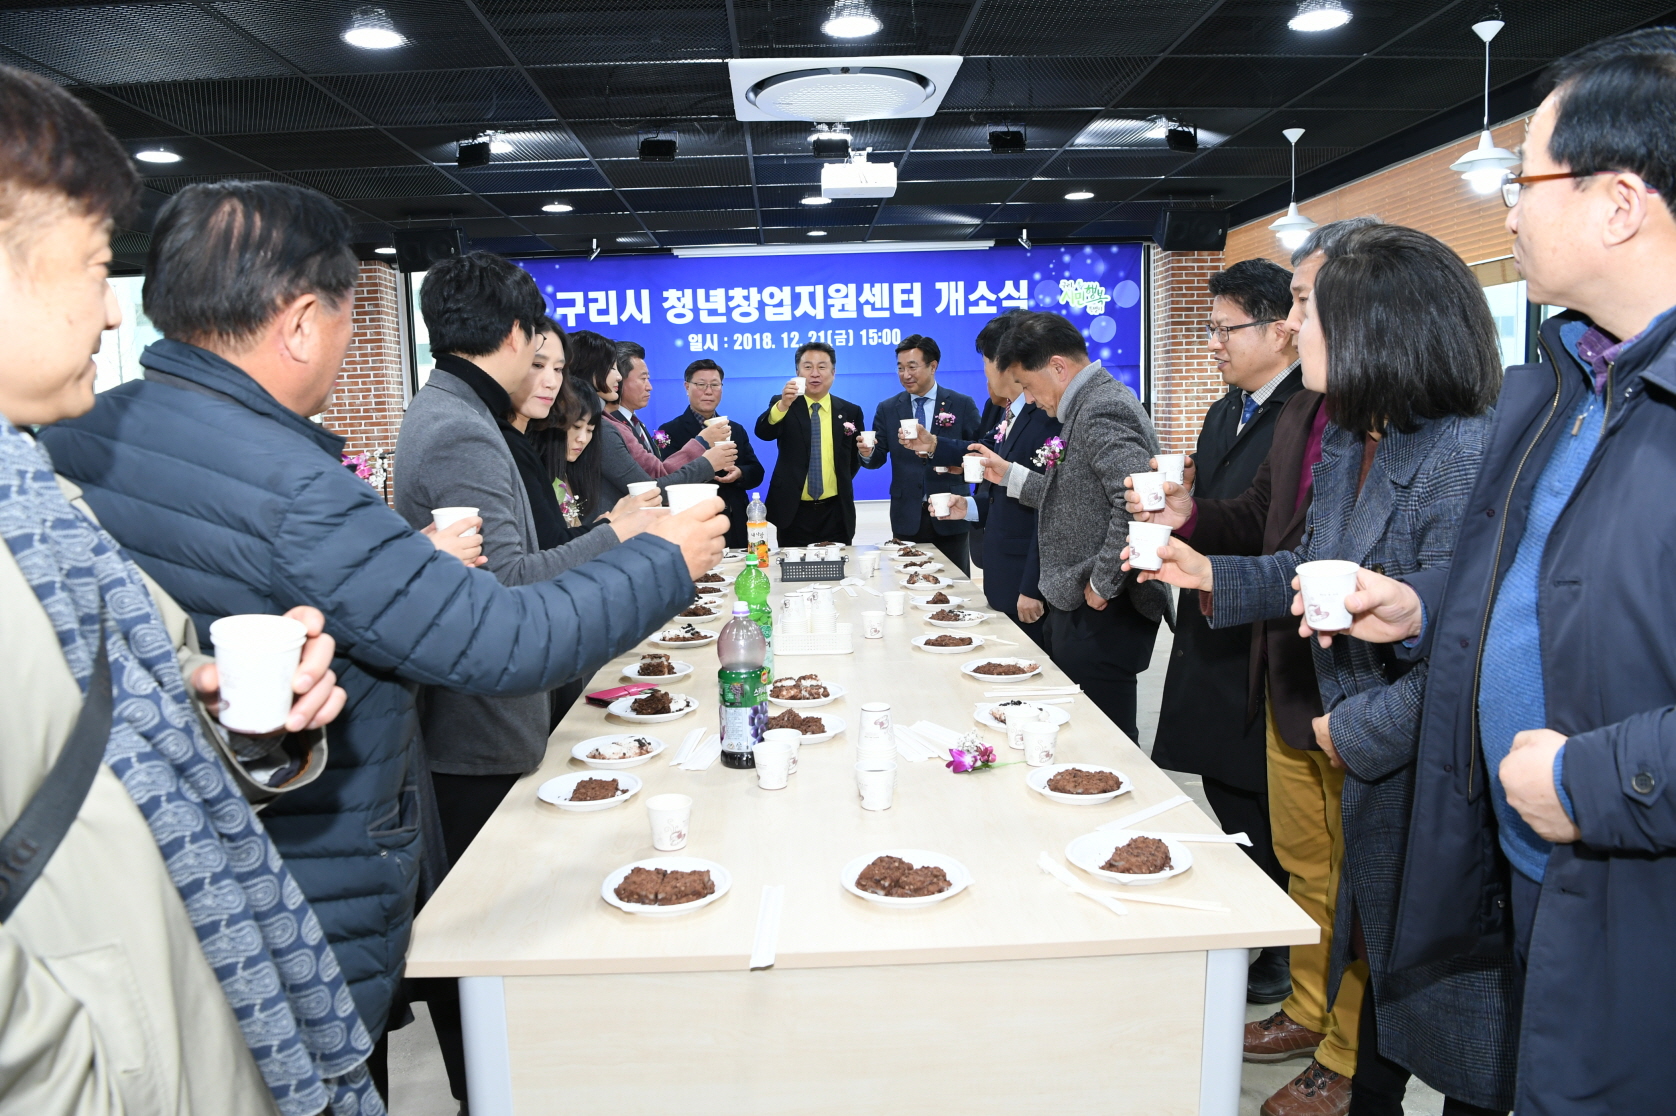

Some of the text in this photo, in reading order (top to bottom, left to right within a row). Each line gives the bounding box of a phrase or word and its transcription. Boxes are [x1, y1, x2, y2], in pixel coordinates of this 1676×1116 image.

[556, 279, 1029, 327] 구리시 청년창업지원센터 개소식
[688, 333, 719, 352] 일시
[733, 332, 776, 350] 2018.
[781, 331, 803, 348] 12.
[807, 329, 854, 347] 21(금)
[860, 328, 901, 346] 15:00
